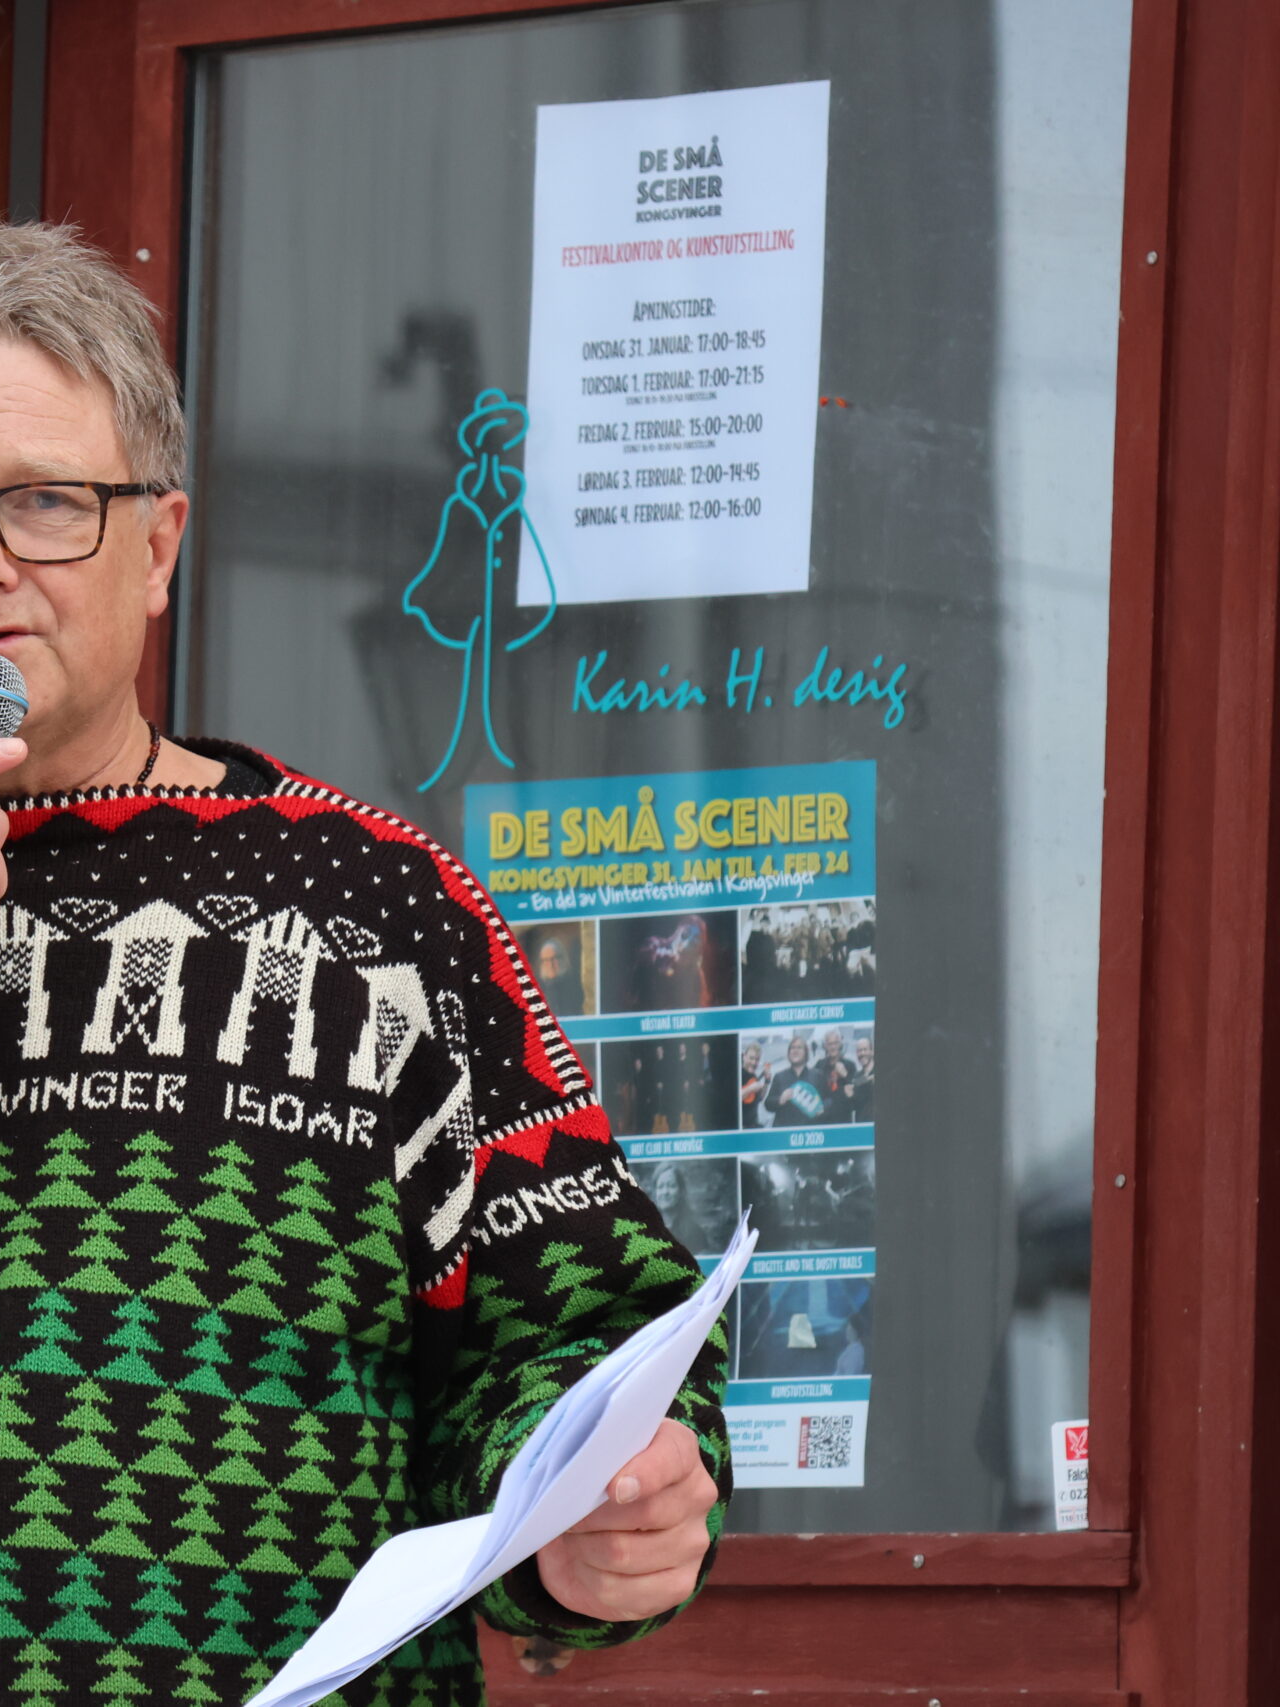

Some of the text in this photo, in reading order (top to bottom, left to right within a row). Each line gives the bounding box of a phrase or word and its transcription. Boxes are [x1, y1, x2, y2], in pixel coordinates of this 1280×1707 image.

[639, 135, 723, 173] DE SMÅ
[636, 175, 723, 204] SCENER
[635, 205, 722, 223] KONGSVINGER
[562, 229, 795, 267] FESTIVALKONTOR OG KUNSTUTSTILLING
[582, 340, 626, 361] ONSDAG
[697, 329, 766, 352] 17:00-18:45
[581, 374, 629, 396] TORSDAG
[698, 365, 765, 388] 17:00-21:15
[578, 422, 619, 444] FREDAG
[688, 413, 763, 437] 15:00-20:00
[578, 470, 620, 492] LØRDAG
[690, 462, 760, 484] 12:00-14:45
[574, 505, 618, 528] SØNDAG
[688, 497, 762, 520] 12:00-16:00
[572, 645, 907, 729] Karin H. desig
[488, 785, 850, 861] DE SMÅ SCENER
[488, 862, 649, 893] KONGSVINGER
[681, 856, 722, 883] JAN
[783, 851, 822, 875] FEB
[823, 850, 850, 874] 24
[531, 891, 553, 911] En
[554, 887, 577, 910] del
[579, 891, 597, 907] av
[597, 875, 715, 907] Vinterfestivalen
[724, 869, 816, 902] Kongsvinger
[771, 1382, 833, 1399] KUNSTUTSTILLING
